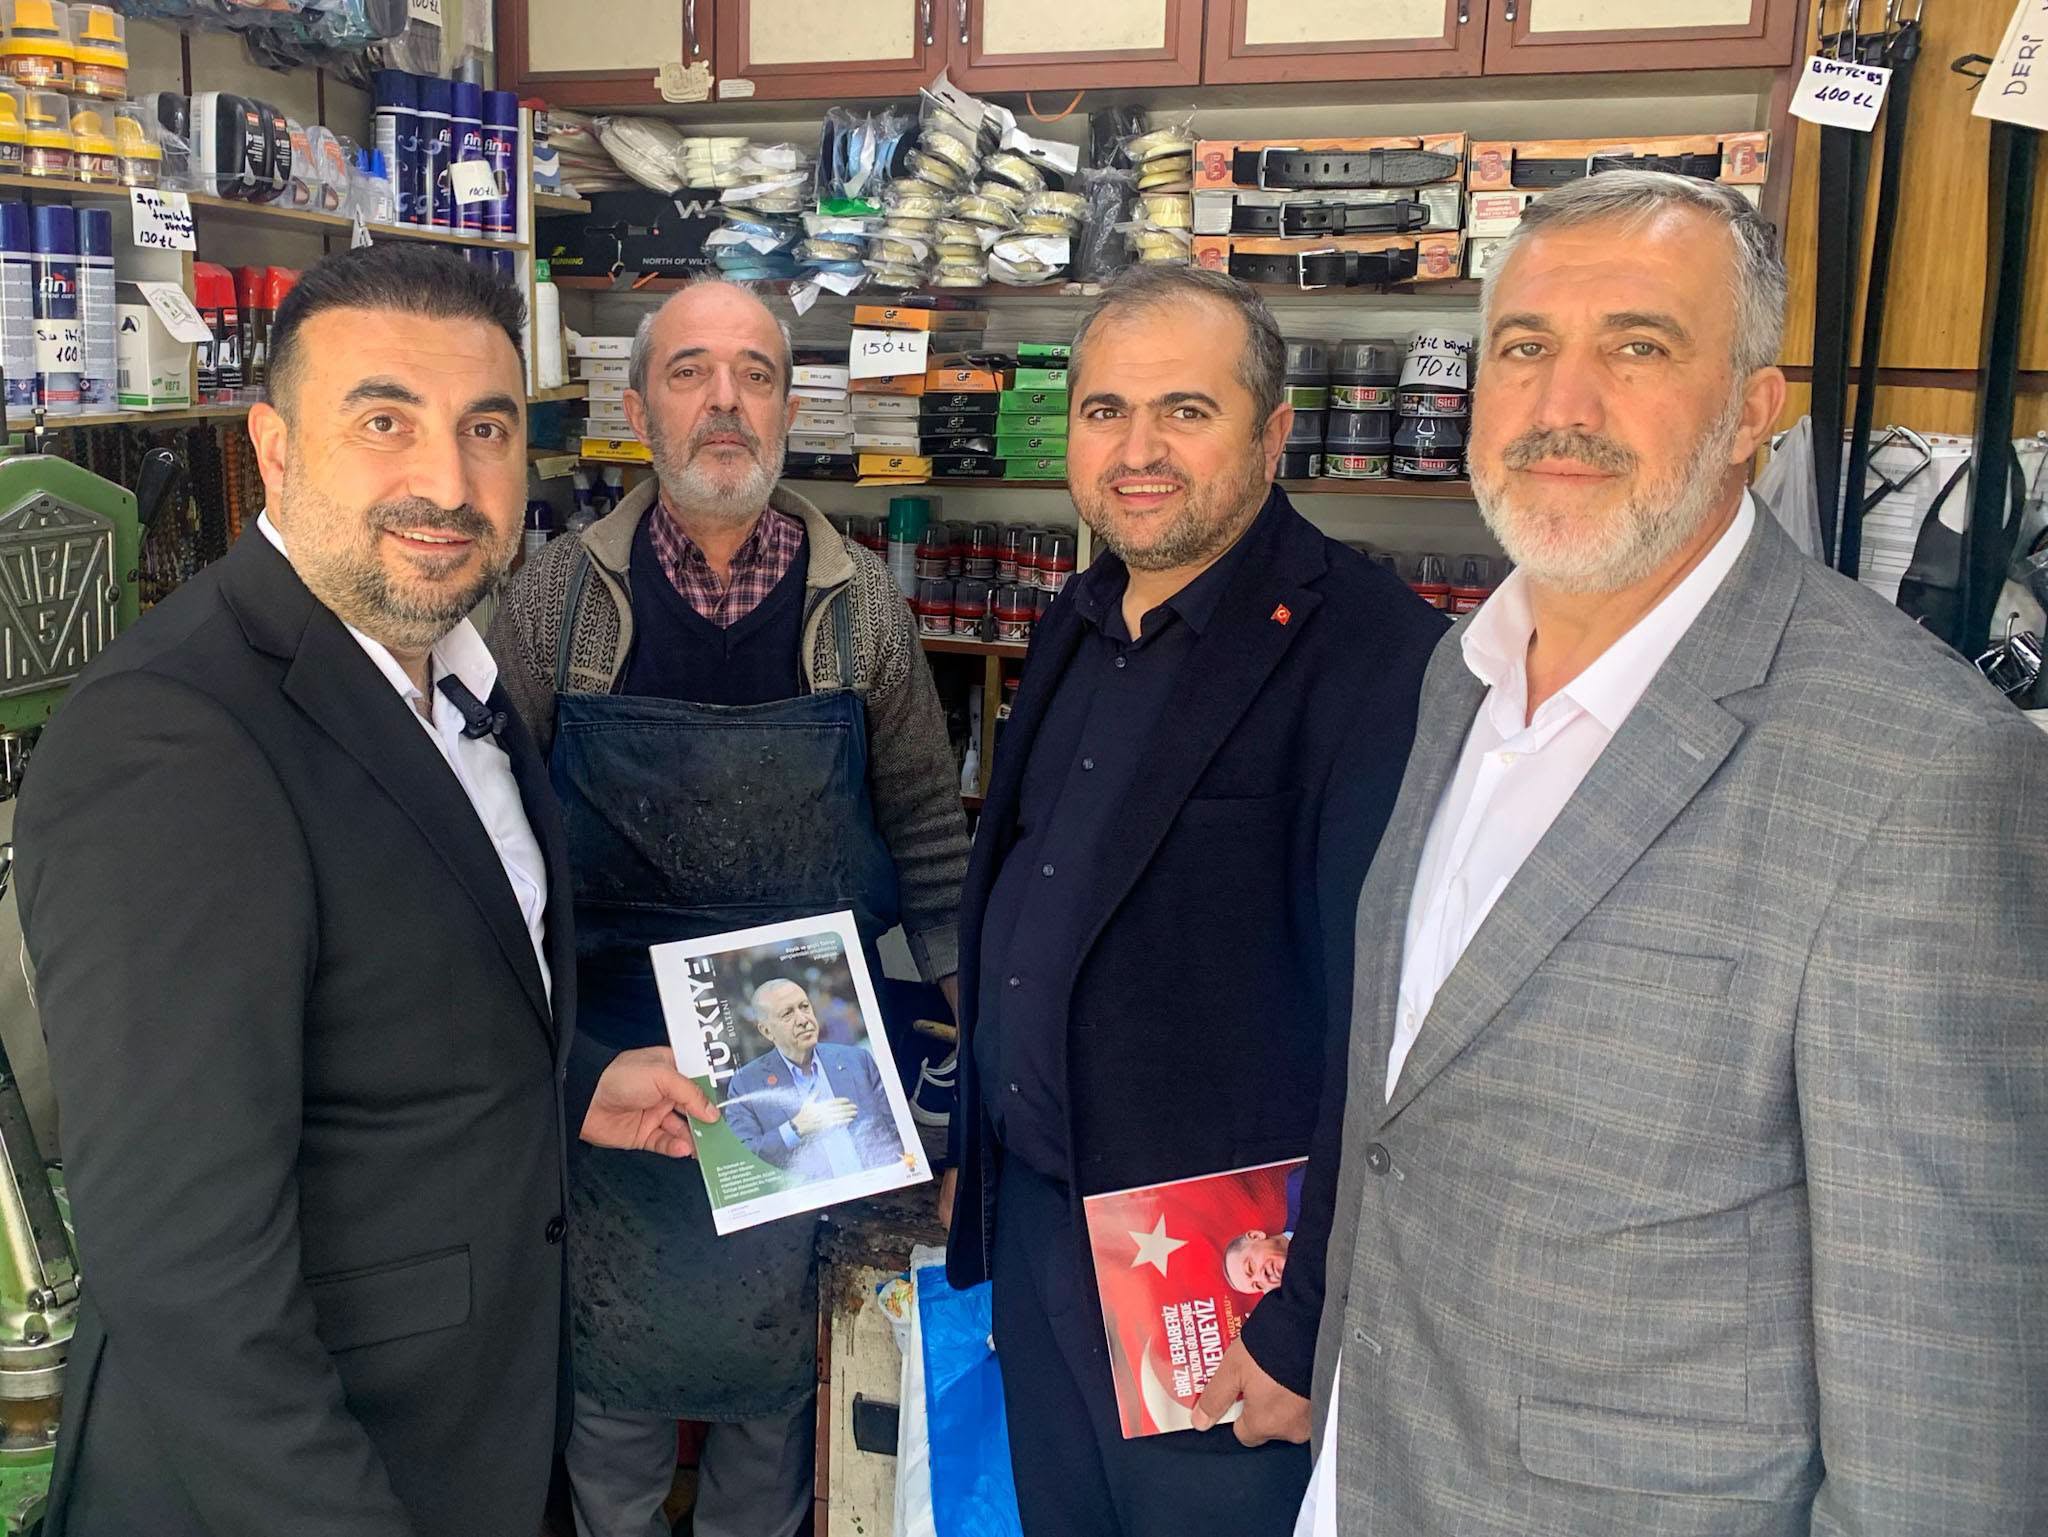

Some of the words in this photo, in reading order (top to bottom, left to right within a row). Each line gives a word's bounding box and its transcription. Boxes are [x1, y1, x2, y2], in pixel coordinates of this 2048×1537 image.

[884, 310, 898, 319] GF
[957, 372, 971, 381] GF
[1032, 394, 1046, 403] GF
[1437, 398, 1458, 407] Sitil
[1027, 416, 1042, 426] GF
[1028, 439, 1043, 448] GF
[889, 458, 903, 468] GF
[684, 958, 735, 1088] TÜRKİYE
[1161, 1304, 1187, 1365] BERABERİZ
